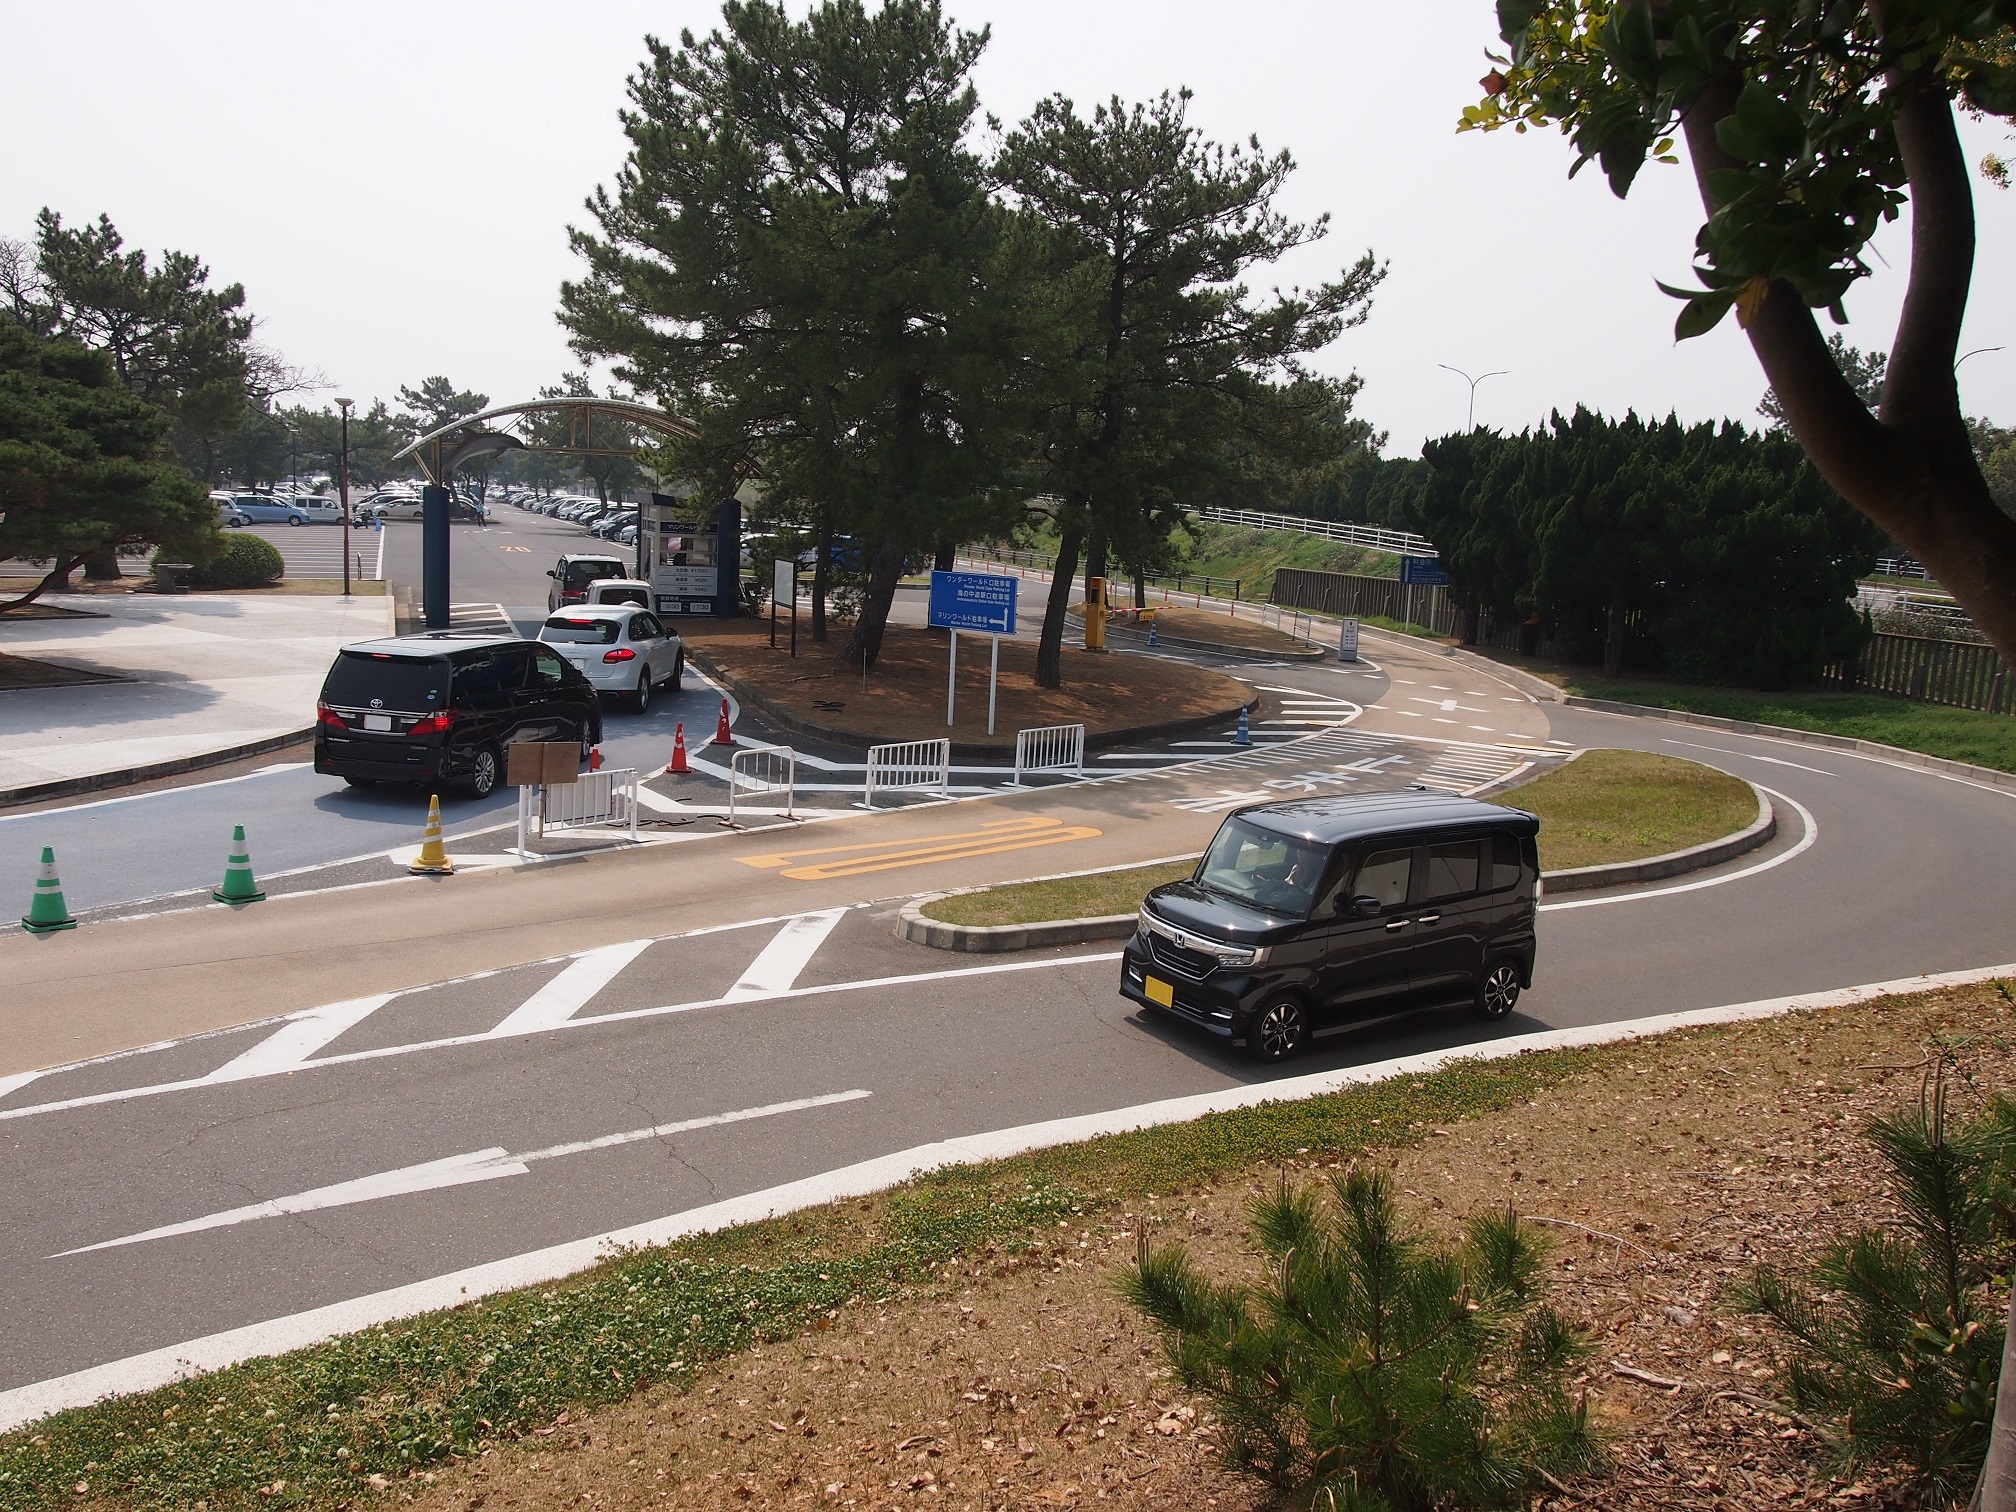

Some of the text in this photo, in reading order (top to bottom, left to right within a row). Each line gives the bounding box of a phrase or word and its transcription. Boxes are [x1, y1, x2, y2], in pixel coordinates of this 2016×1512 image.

[938, 612, 987, 623] マリンワールド駐車場
